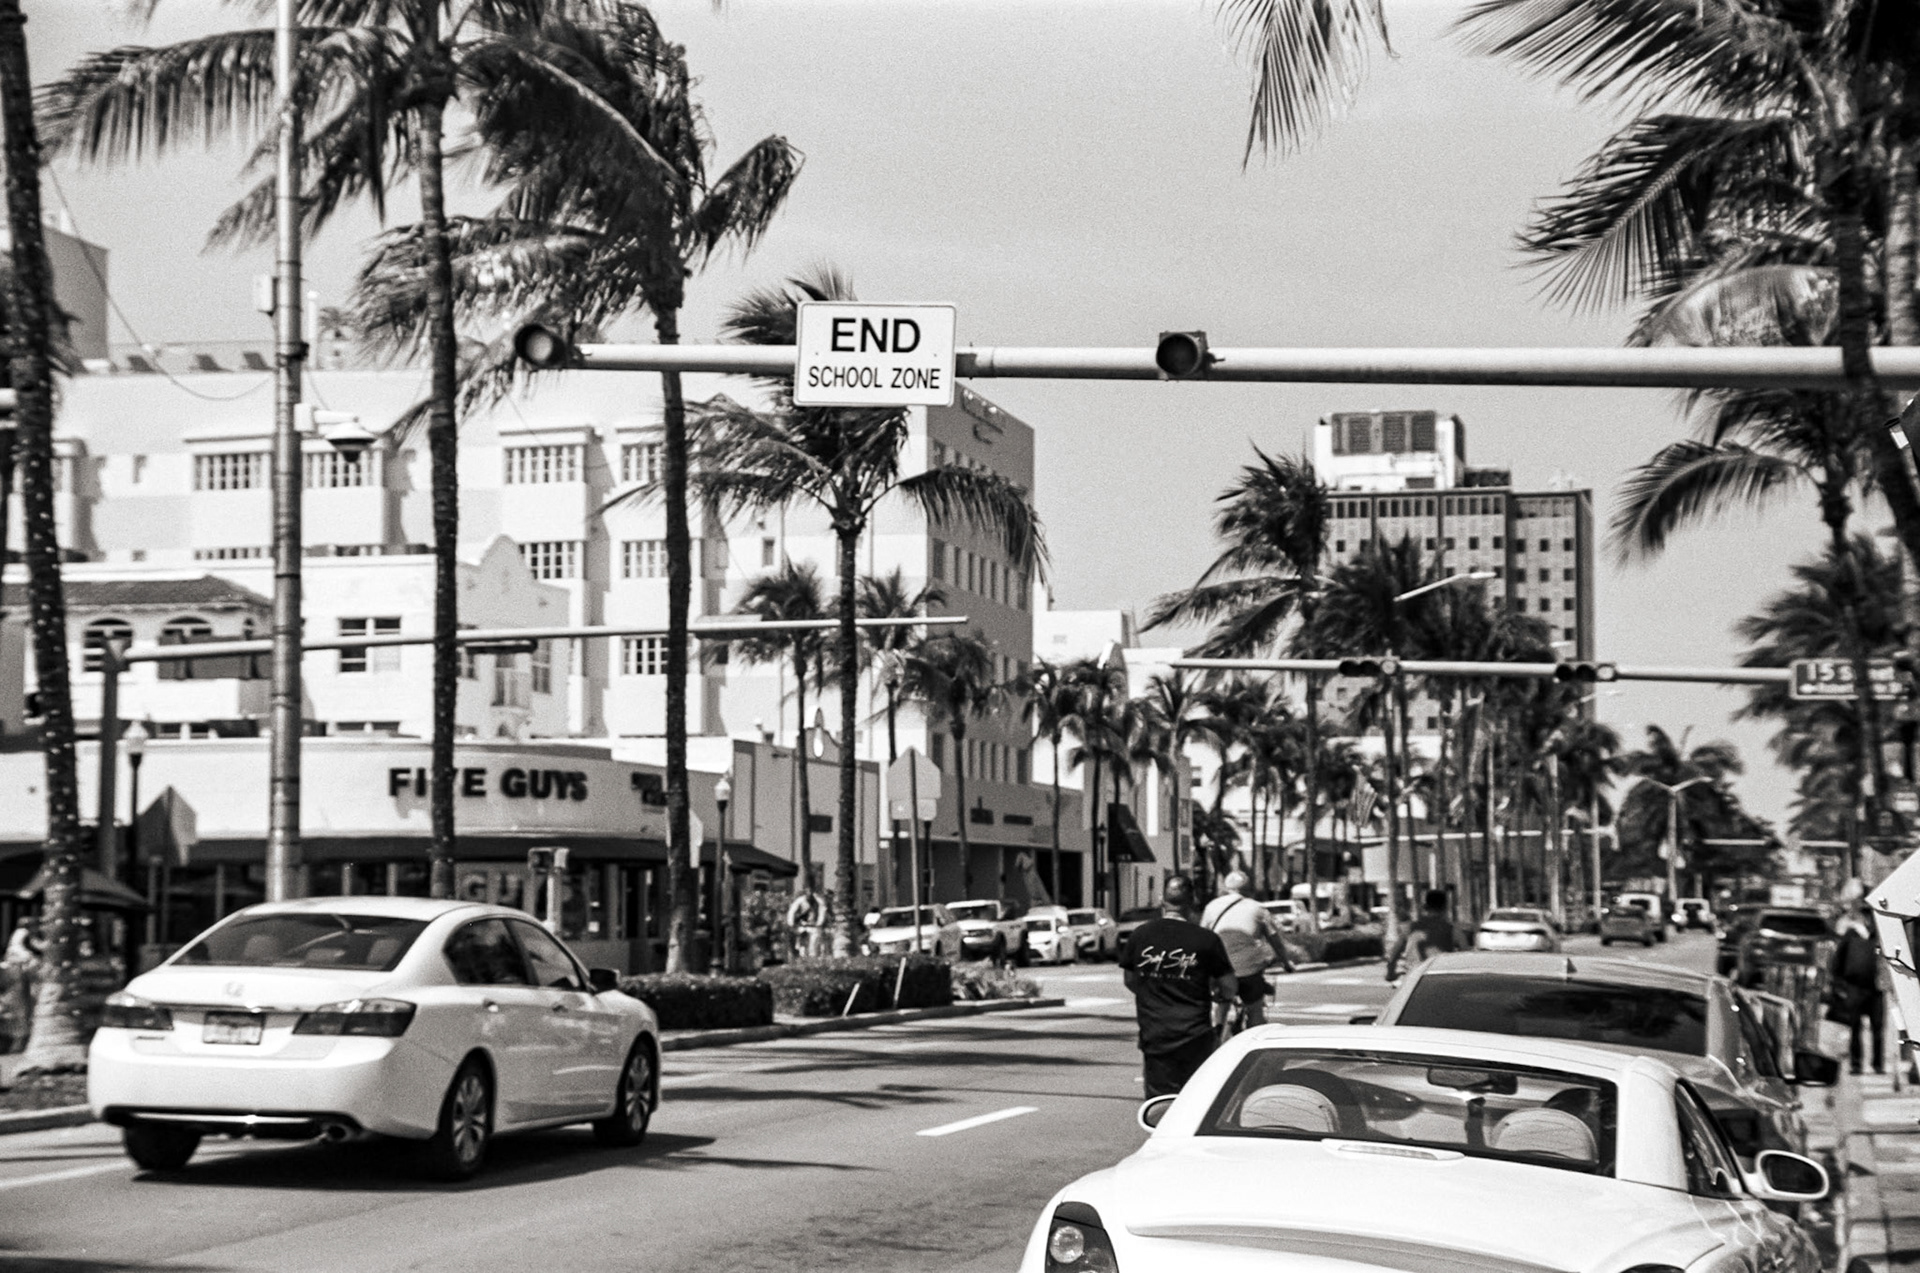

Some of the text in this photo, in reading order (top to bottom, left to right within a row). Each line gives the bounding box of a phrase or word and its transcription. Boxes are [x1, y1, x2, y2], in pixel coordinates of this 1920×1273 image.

[831, 317, 921, 353] END
[808, 366, 941, 389] SCHOOL ZONE
[389, 767, 588, 801] FIE GUYS
